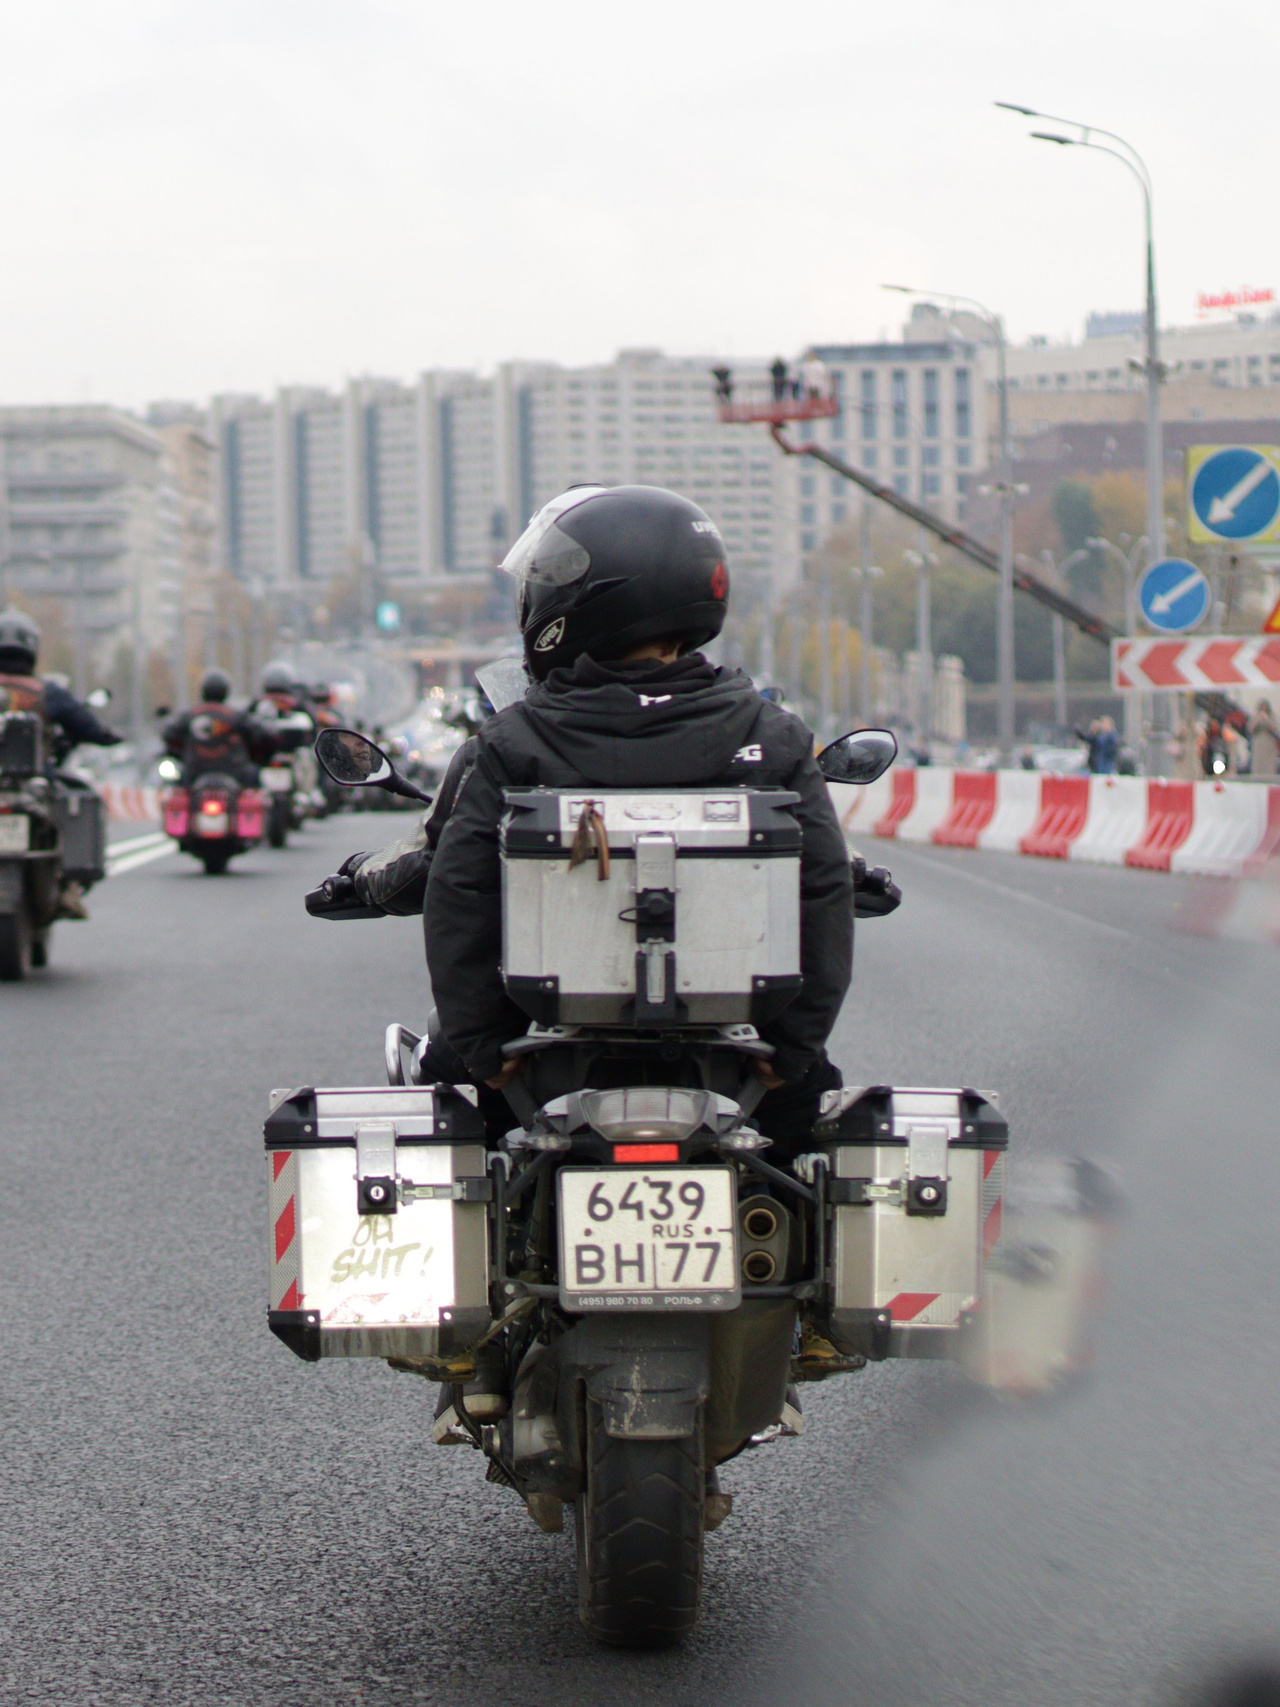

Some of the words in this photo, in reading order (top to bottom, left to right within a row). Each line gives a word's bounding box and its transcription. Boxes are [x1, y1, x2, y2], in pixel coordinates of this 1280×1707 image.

[538, 624, 561, 647] uvex
[587, 1181, 705, 1222] 6439
[652, 1224, 695, 1238] RUS
[665, 1242, 721, 1282] 77
[578, 1297, 604, 1306] (495)
[606, 1297, 625, 1305] 980
[626, 1297, 640, 1305] 70
[640, 1297, 653, 1305] 80
[664, 1296, 703, 1305] РОЛЬФ
